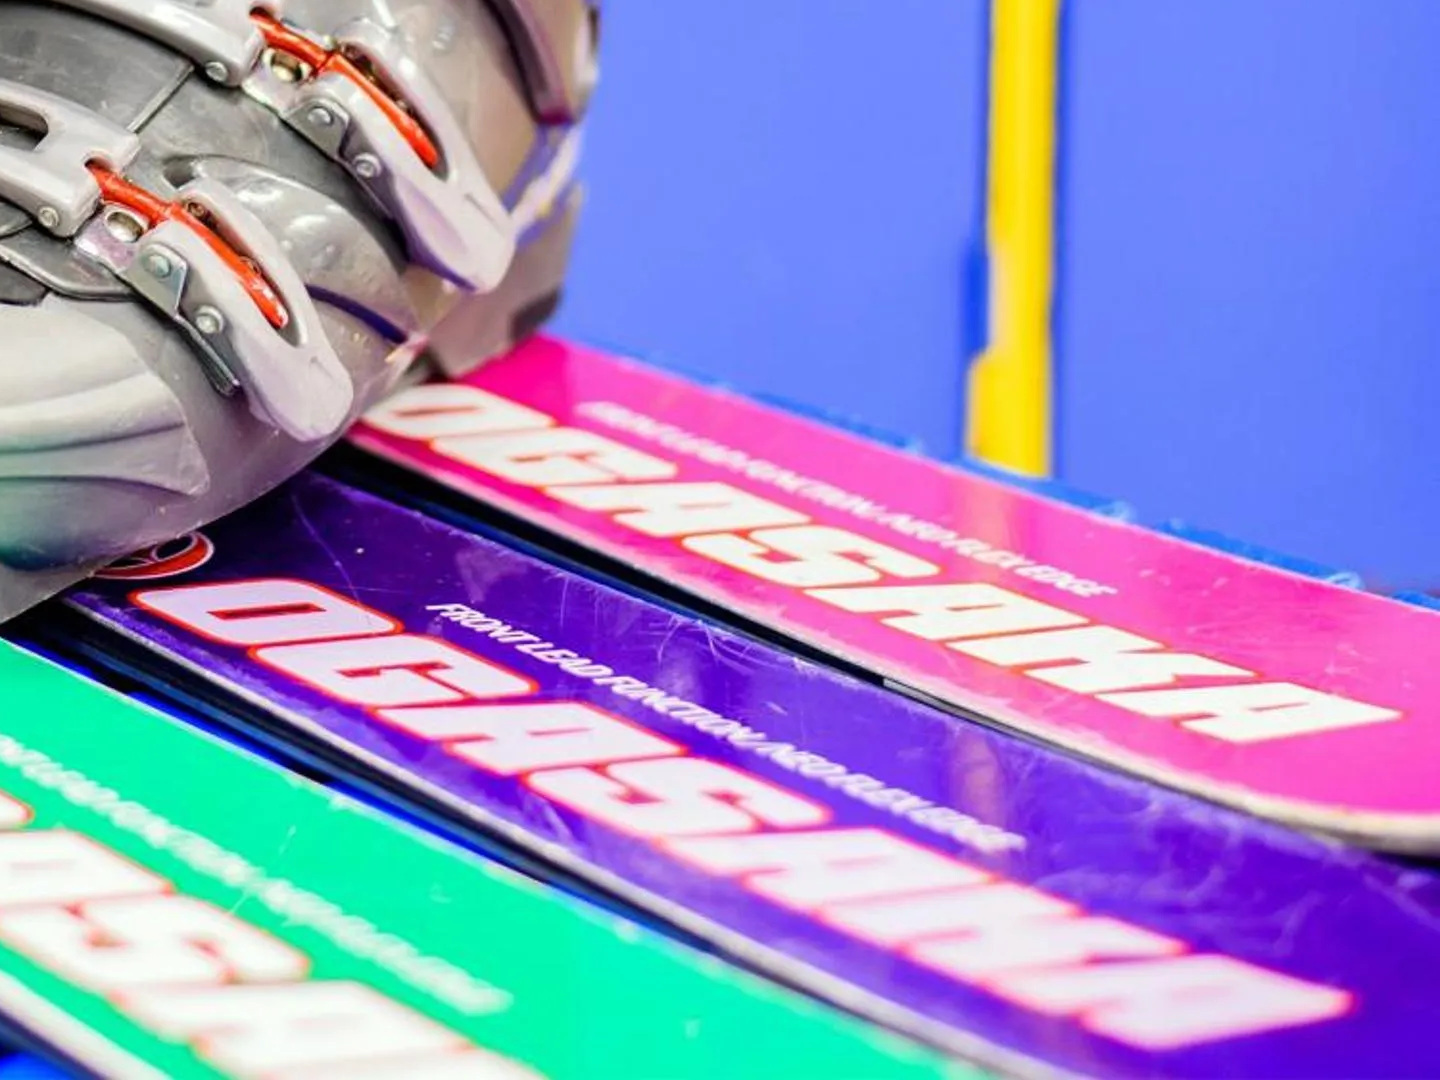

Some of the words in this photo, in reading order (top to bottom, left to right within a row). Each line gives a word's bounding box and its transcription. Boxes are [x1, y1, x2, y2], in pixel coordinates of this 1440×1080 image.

[357, 383, 1404, 745] OGASAKA
[425, 603, 541, 644] FRONT
[514, 641, 614, 678] LEAD
[128, 577, 1357, 1051] OGASAKA
